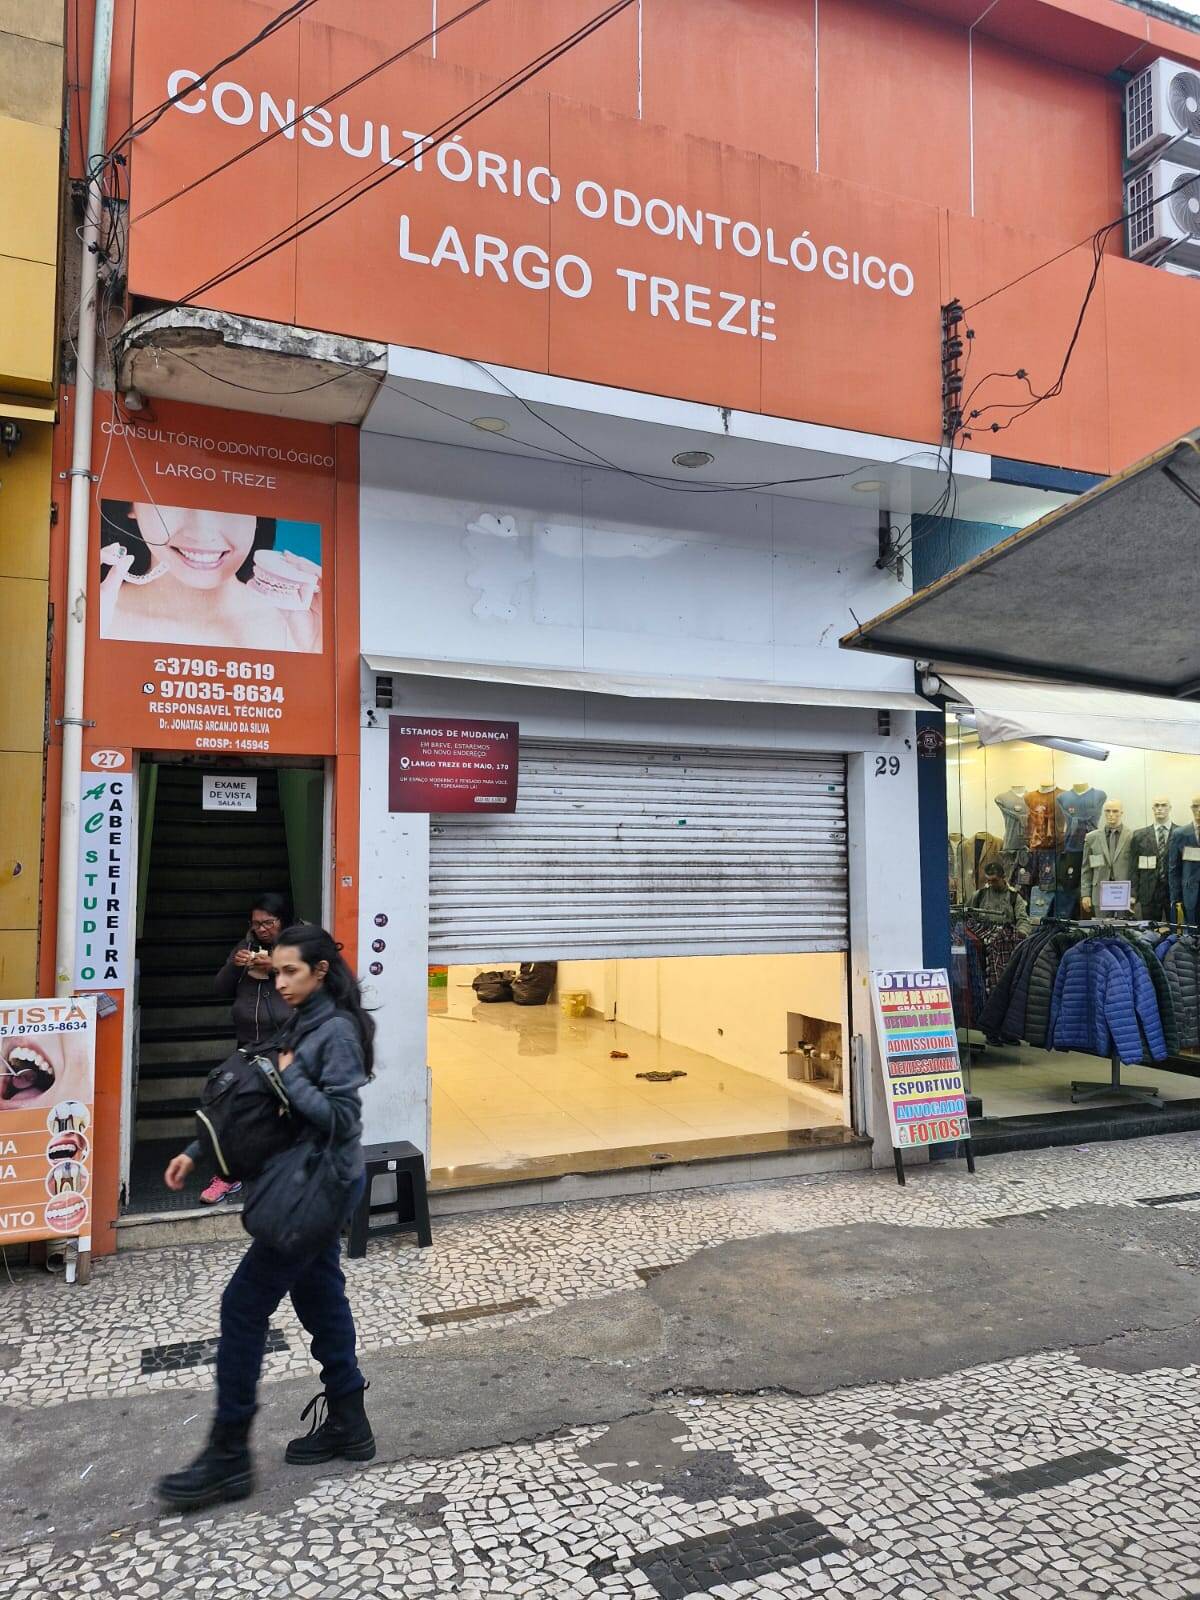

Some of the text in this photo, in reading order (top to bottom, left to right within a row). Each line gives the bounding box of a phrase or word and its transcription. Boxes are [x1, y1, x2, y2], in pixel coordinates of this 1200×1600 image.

[166, 69, 915, 297] CONSULTÓRIO ODONTOLÓGICO
[399, 215, 777, 341] LARGO TREZE
[100, 421, 335, 468] CONSULTÓRIO ODONTOLÓGICO
[155, 461, 276, 490] LARGO TREZE
[167, 657, 275, 681] 3796-8619
[160, 680, 285, 703] 97035-8634
[159, 719, 270, 734] Dr. JONATAS ARCANJO DA SILVA
[400, 728, 509, 740] ESTAMOS DE MUDANÇA!
[195, 738, 270, 750] CROSP: 145945
[97, 753, 118, 766] 27
[874, 756, 901, 777] 29
[210, 790, 251, 799] DE VISTA
[215, 781, 247, 790] EXAME
[81, 782, 107, 981] A C STUDIO
[103, 782, 123, 980] CABELEIREIRA
[18, 1021, 87, 1034] 97035-8634
[887, 1036, 955, 1053] ADMISSIONAL
[889, 1057, 958, 1076] DEMISSIONAL
[892, 1077, 962, 1096] ESPORTIVO
[896, 1099, 965, 1120] ADVOGADO
[908, 1119, 960, 1143] FOTOS
